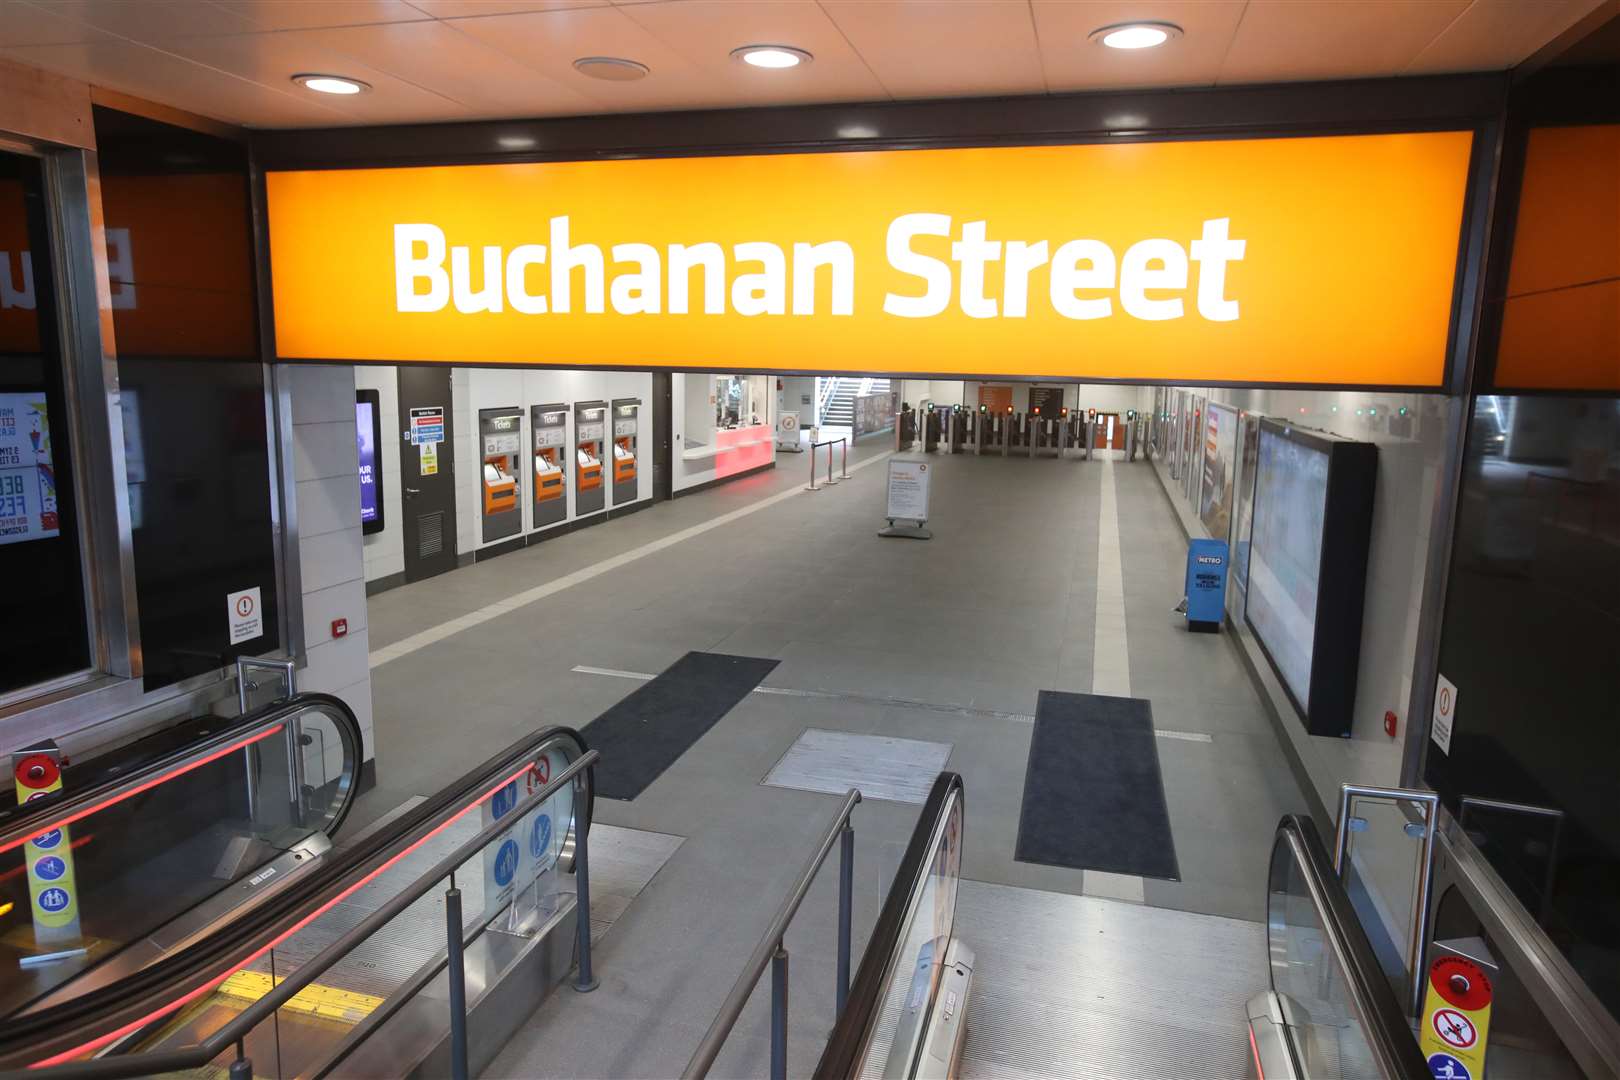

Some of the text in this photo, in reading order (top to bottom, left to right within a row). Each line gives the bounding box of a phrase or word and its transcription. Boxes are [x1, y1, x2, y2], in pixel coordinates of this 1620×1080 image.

[394, 213, 1246, 321] Buchanan Street
[1199, 556, 1222, 565] METRO
